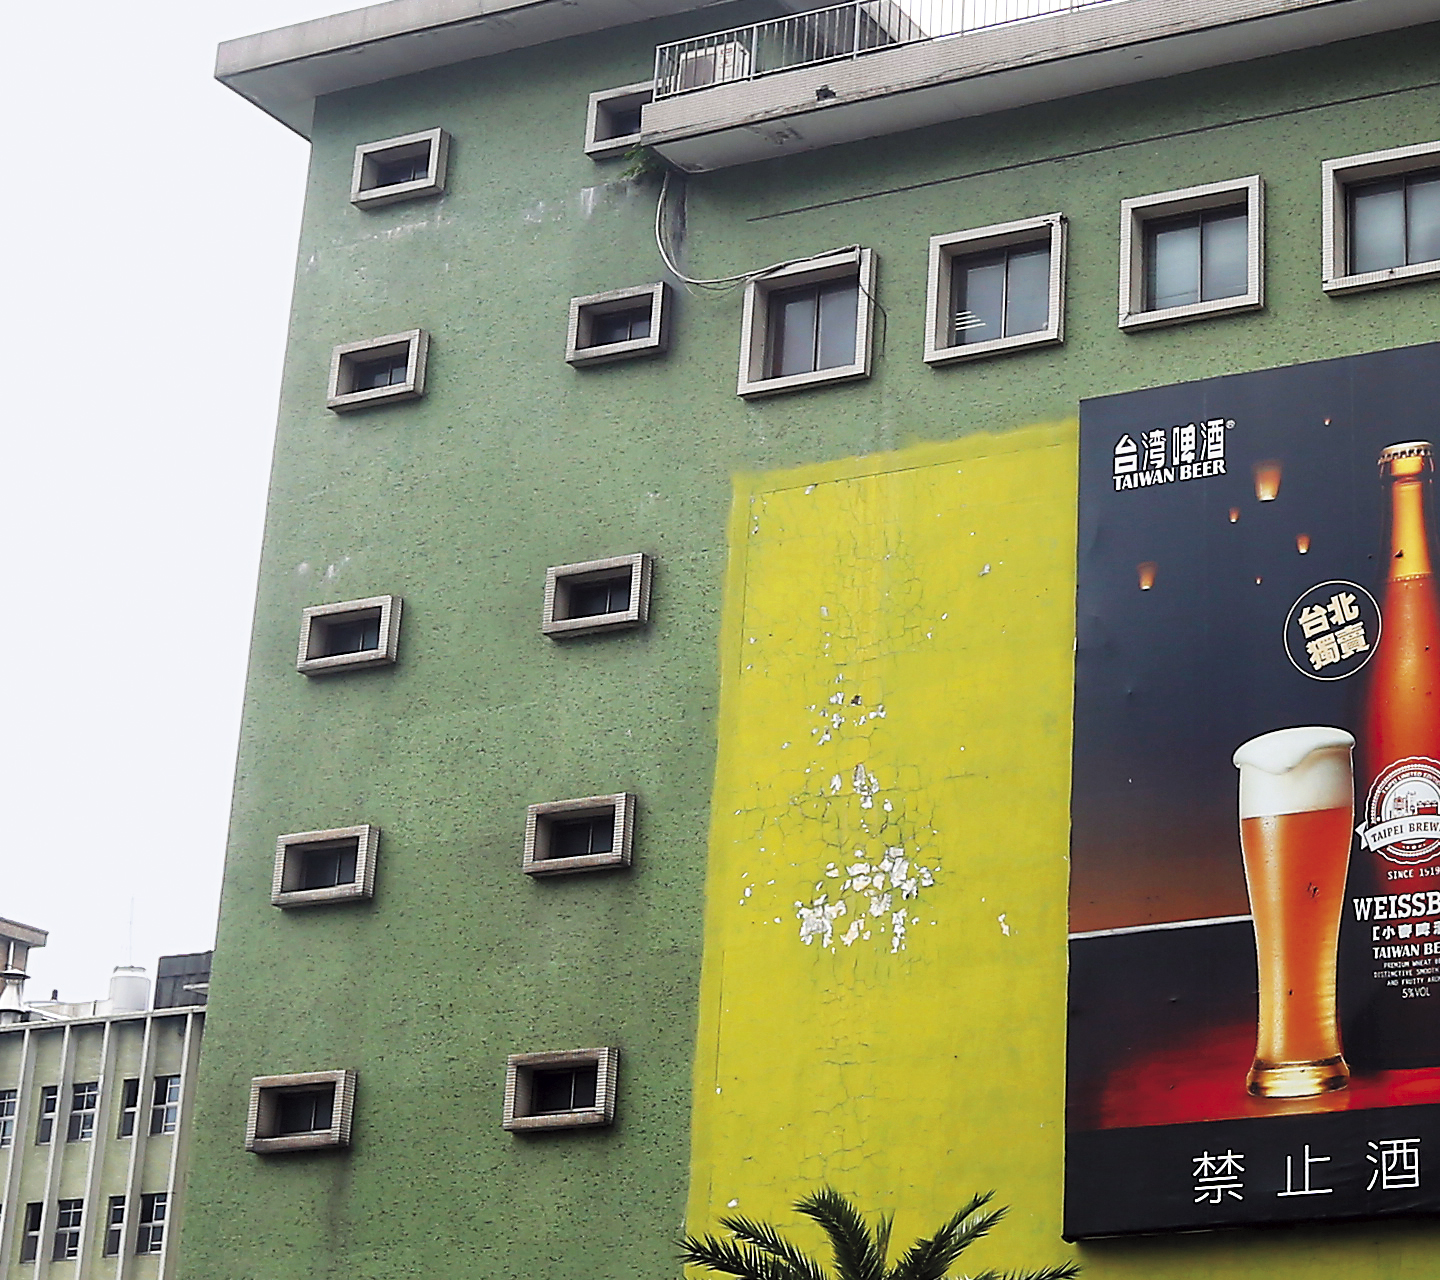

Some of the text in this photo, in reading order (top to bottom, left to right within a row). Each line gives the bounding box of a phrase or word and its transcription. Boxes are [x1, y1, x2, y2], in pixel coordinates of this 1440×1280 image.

[1112, 459, 1227, 491] TAIWAN BEER
[1298, 592, 1360, 639] 台北
[1305, 621, 1370, 671] 獨賣
[1371, 824, 1403, 843] TAIPEI
[1387, 869, 1414, 880] SINCE
[1372, 944, 1420, 959] TAIWAN
[1373, 969, 1413, 978] DISTINCTIVE
[1383, 961, 1410, 969] PREMIUM
